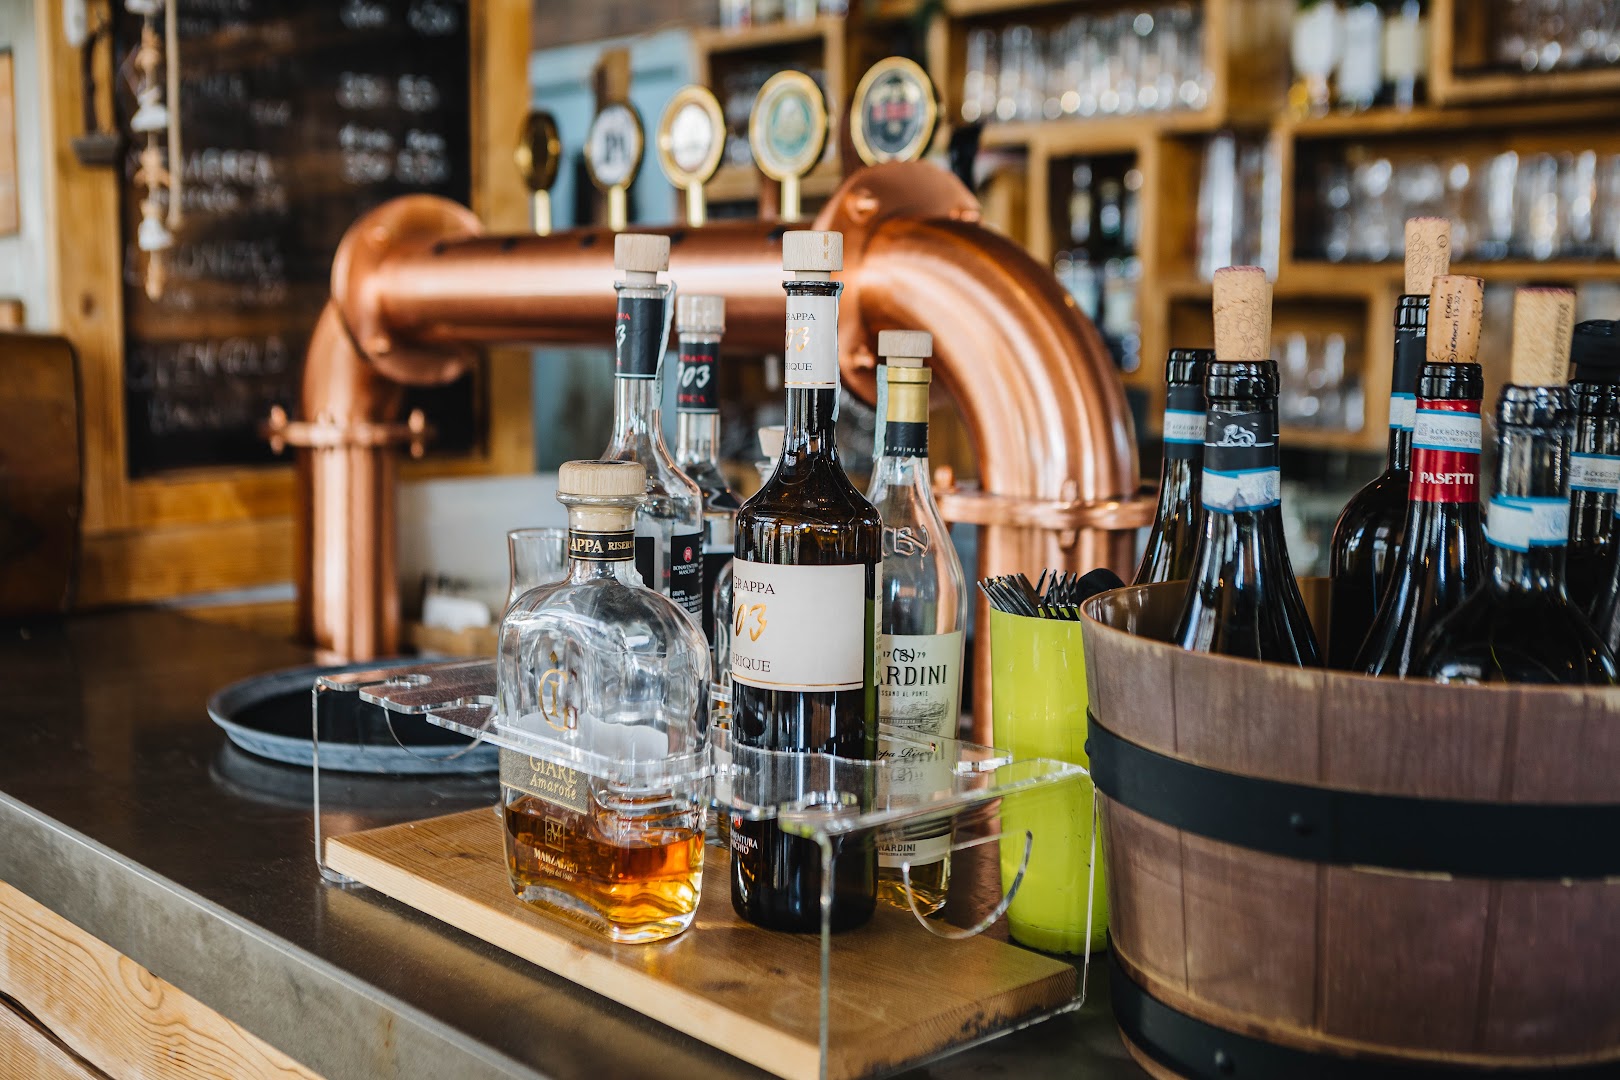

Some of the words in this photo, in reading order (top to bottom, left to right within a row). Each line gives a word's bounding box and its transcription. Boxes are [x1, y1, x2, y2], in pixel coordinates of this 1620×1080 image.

[1420, 471, 1474, 485] PASETTI
[734, 575, 775, 595] GRAPPA
[529, 755, 578, 788] GIARE
[529, 772, 577, 800] Amarone
